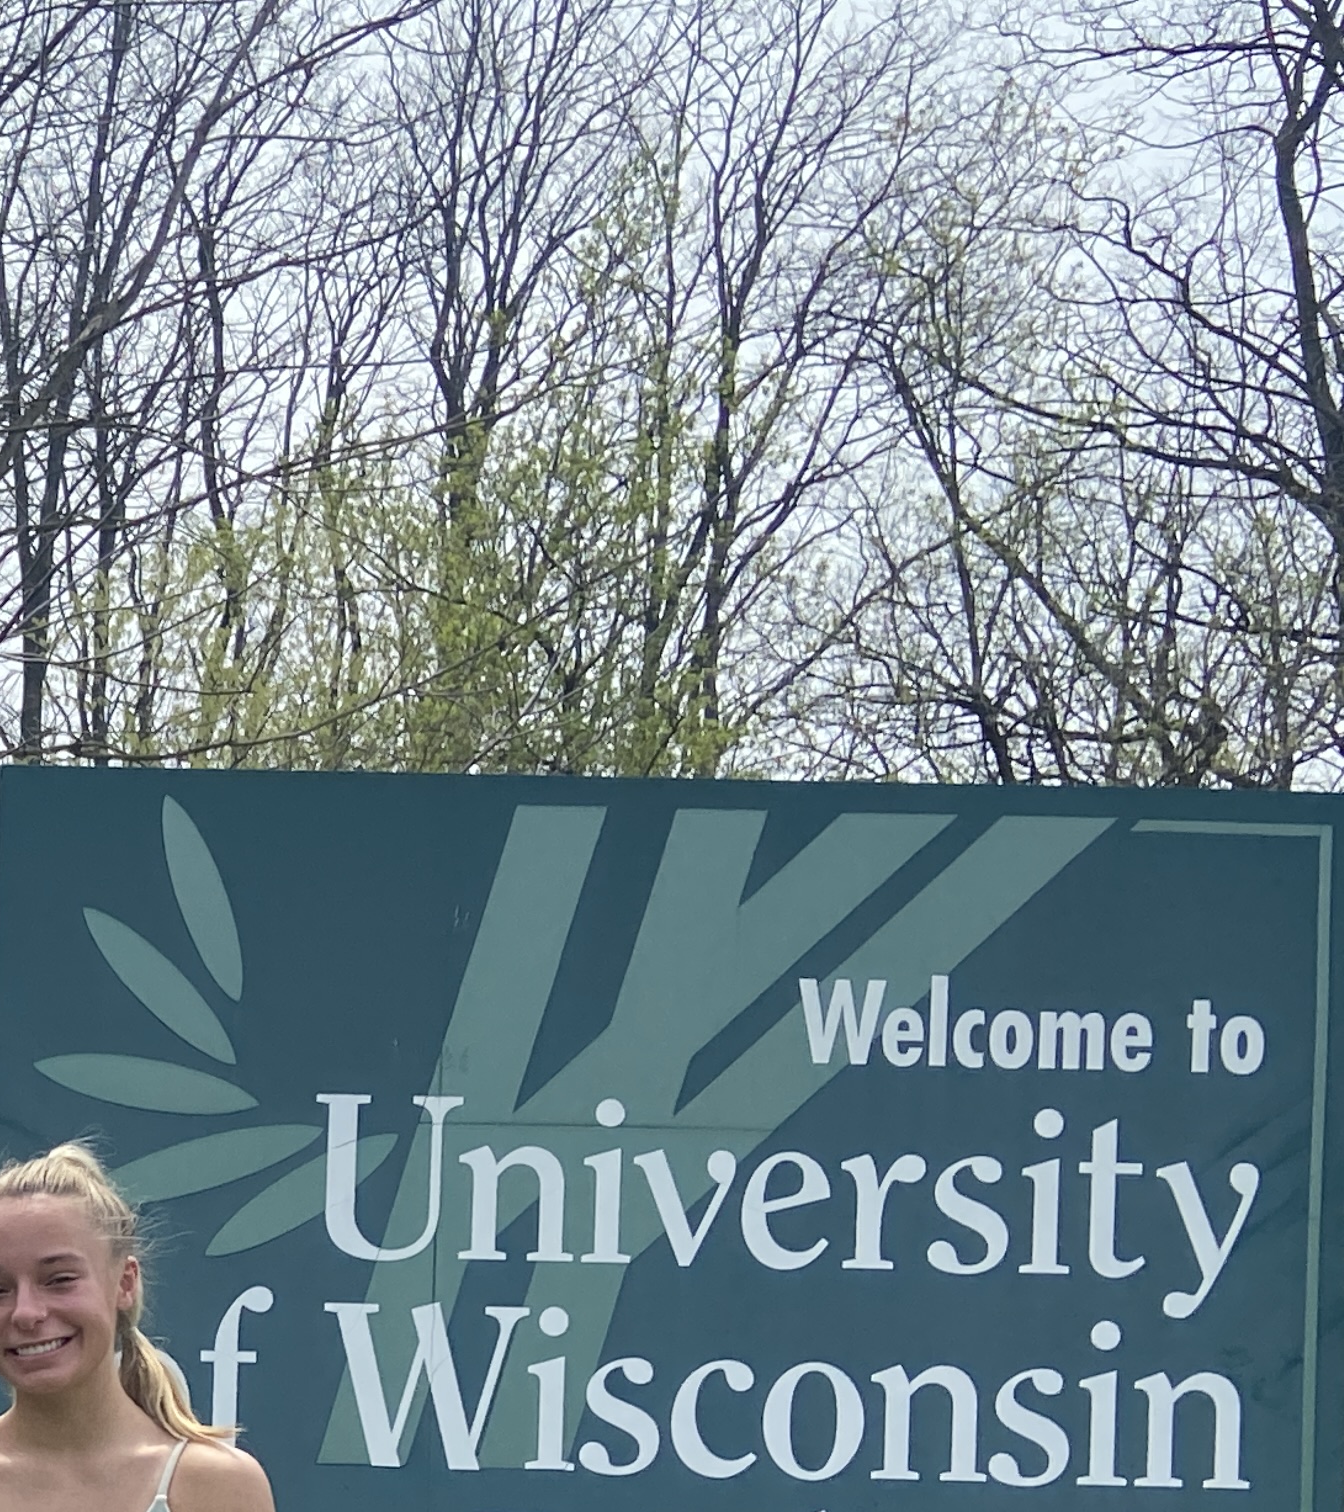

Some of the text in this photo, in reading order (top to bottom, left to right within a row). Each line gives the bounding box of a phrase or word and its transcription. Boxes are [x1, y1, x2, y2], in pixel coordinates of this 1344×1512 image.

[800, 974, 1266, 1076] Welcome to
[316, 1093, 1260, 1319] University
[324, 1302, 1250, 1491] Wisconsin
